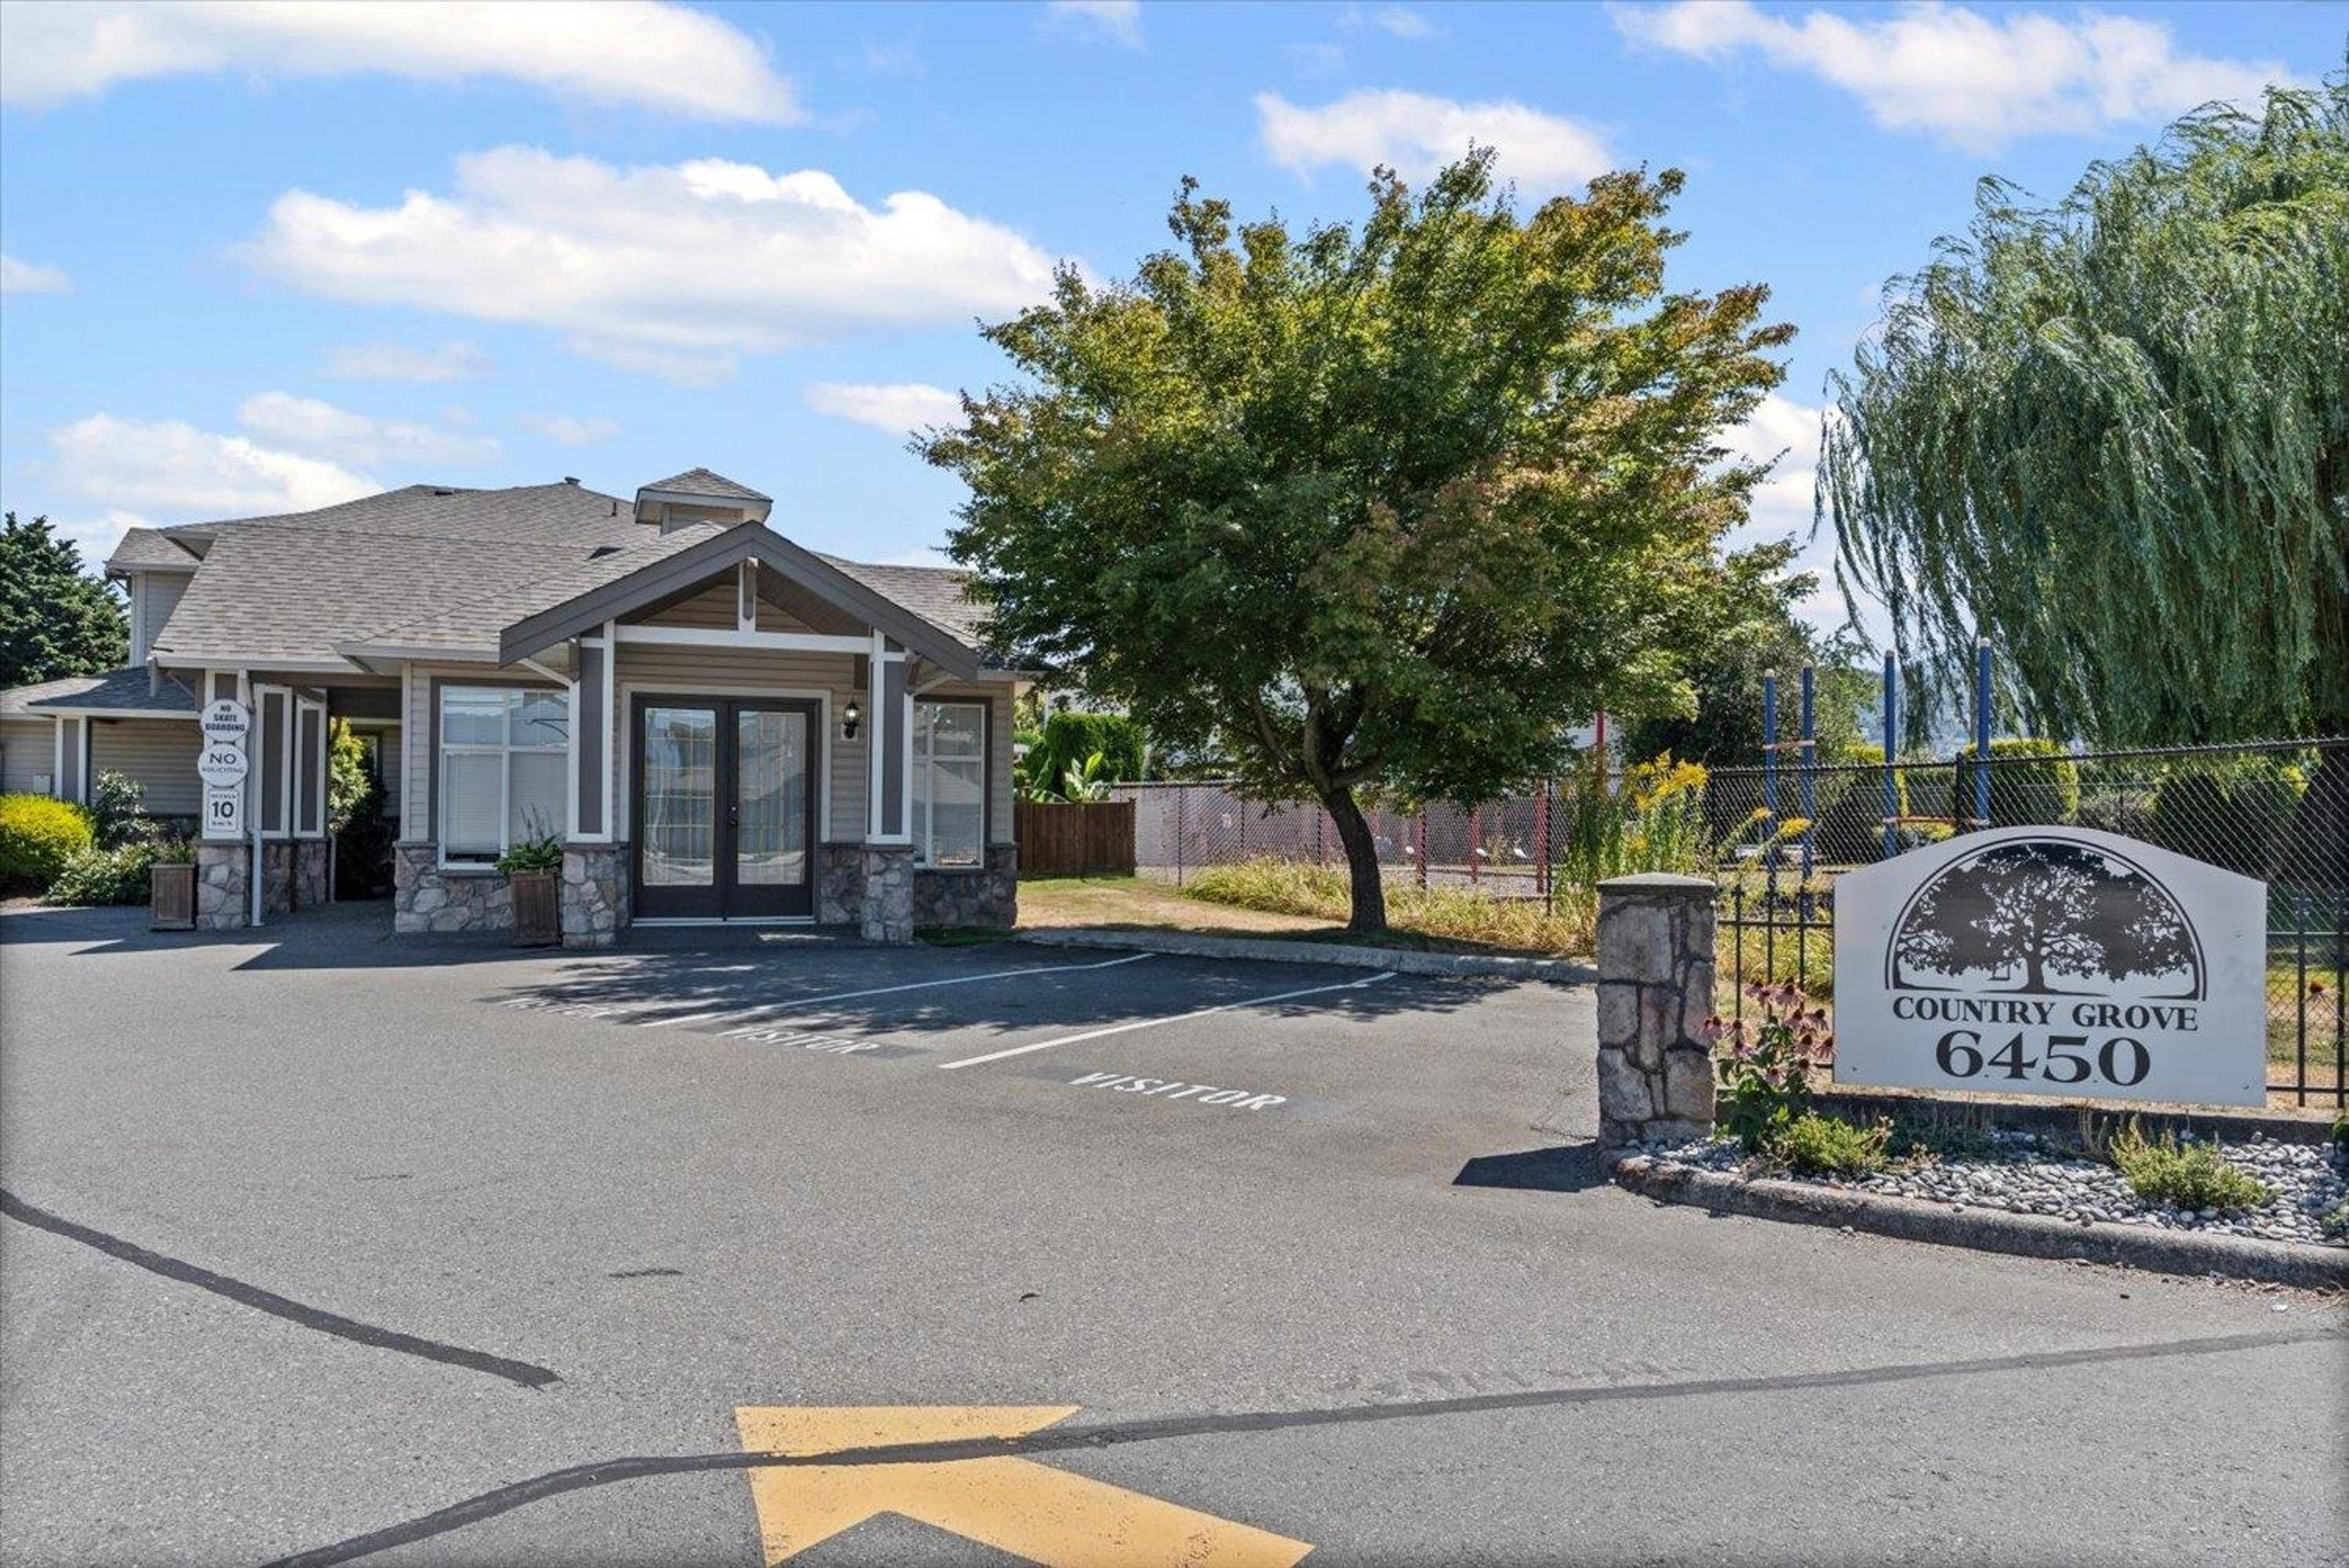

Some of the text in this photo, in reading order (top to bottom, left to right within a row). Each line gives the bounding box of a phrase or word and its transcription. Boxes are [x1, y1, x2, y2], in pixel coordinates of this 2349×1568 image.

[213, 714, 237, 723] SKATE
[210, 753, 236, 764] NO
[212, 801, 234, 818] 10
[1893, 996, 2199, 1031] COUNTRY GROVE
[714, 1027, 879, 1053] VISITOR
[1935, 1030, 2151, 1086] 6450
[1067, 1072, 1286, 1110] VISITOR
